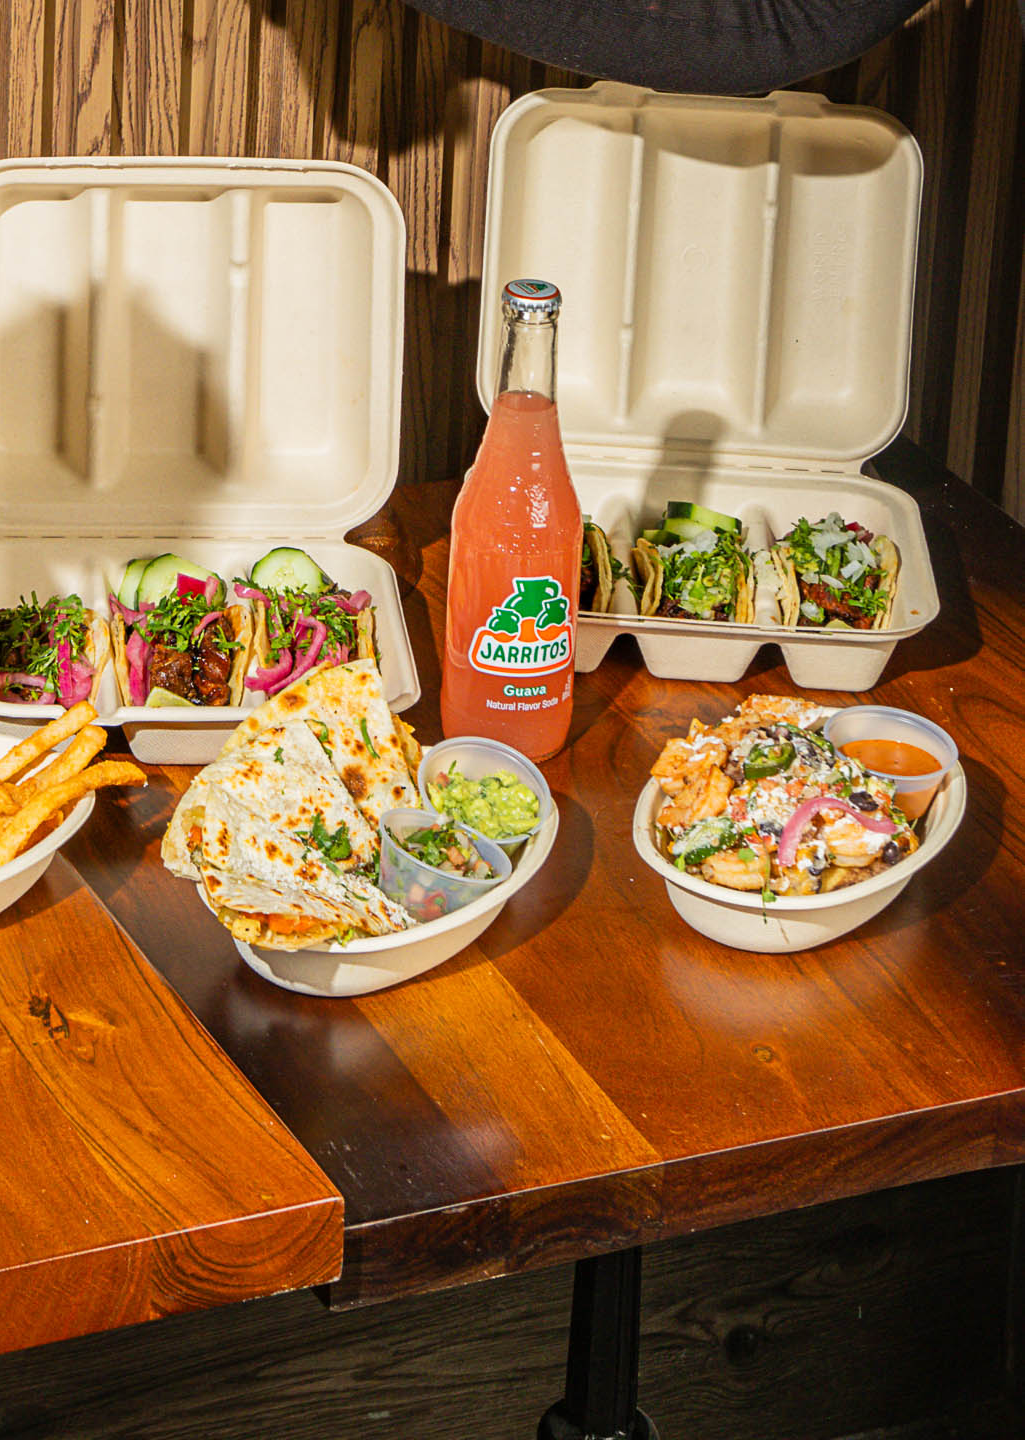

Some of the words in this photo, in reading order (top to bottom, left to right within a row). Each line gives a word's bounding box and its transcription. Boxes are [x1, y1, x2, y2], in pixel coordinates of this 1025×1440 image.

[480, 639, 567, 664] JARRITOS
[504, 684, 547, 697] Guava
[486, 698, 516, 711] Natural
[517, 702, 541, 712] Flavor
[542, 697, 559, 708] Soda
